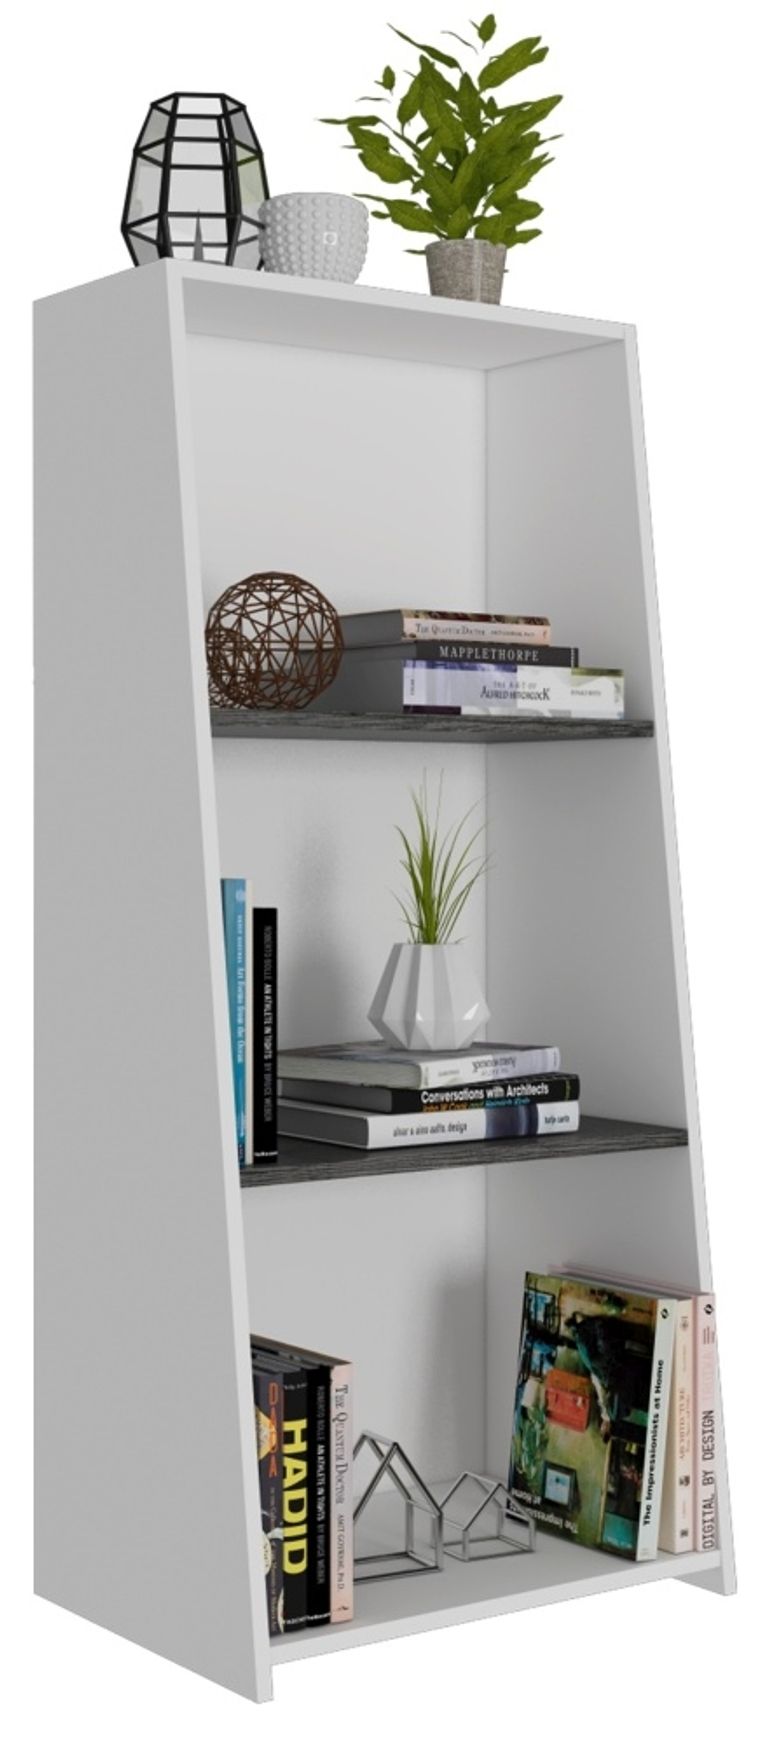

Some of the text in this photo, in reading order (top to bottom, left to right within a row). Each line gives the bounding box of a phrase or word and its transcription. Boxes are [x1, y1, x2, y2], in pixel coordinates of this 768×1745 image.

[439, 646, 539, 662] MAPPLETHORPE
[263, 925, 273, 1122] ROBERTO BOLLE AN ATHLETE IN TIGHTS BY BRUCE WEBER
[420, 1088, 484, 1104] Conversations
[486, 1085, 505, 1098] with
[506, 1082, 549, 1098] Architects
[447, 1121, 468, 1135] design
[268, 1382, 279, 1479] DADA
[643, 1359, 664, 1527] The Impressionists at Home
[702, 1410, 715, 1461] DESIGN
[282, 1417, 308, 1575] HADID
[316, 1385, 326, 1584] ROBERTO BOLLE AN ATHLETE IN TIGHTS BY BRUCE WEBER
[702, 1470, 714, 1486] BY
[564, 1520, 579, 1535] The
[702, 1492, 715, 1550] DIGITAL
